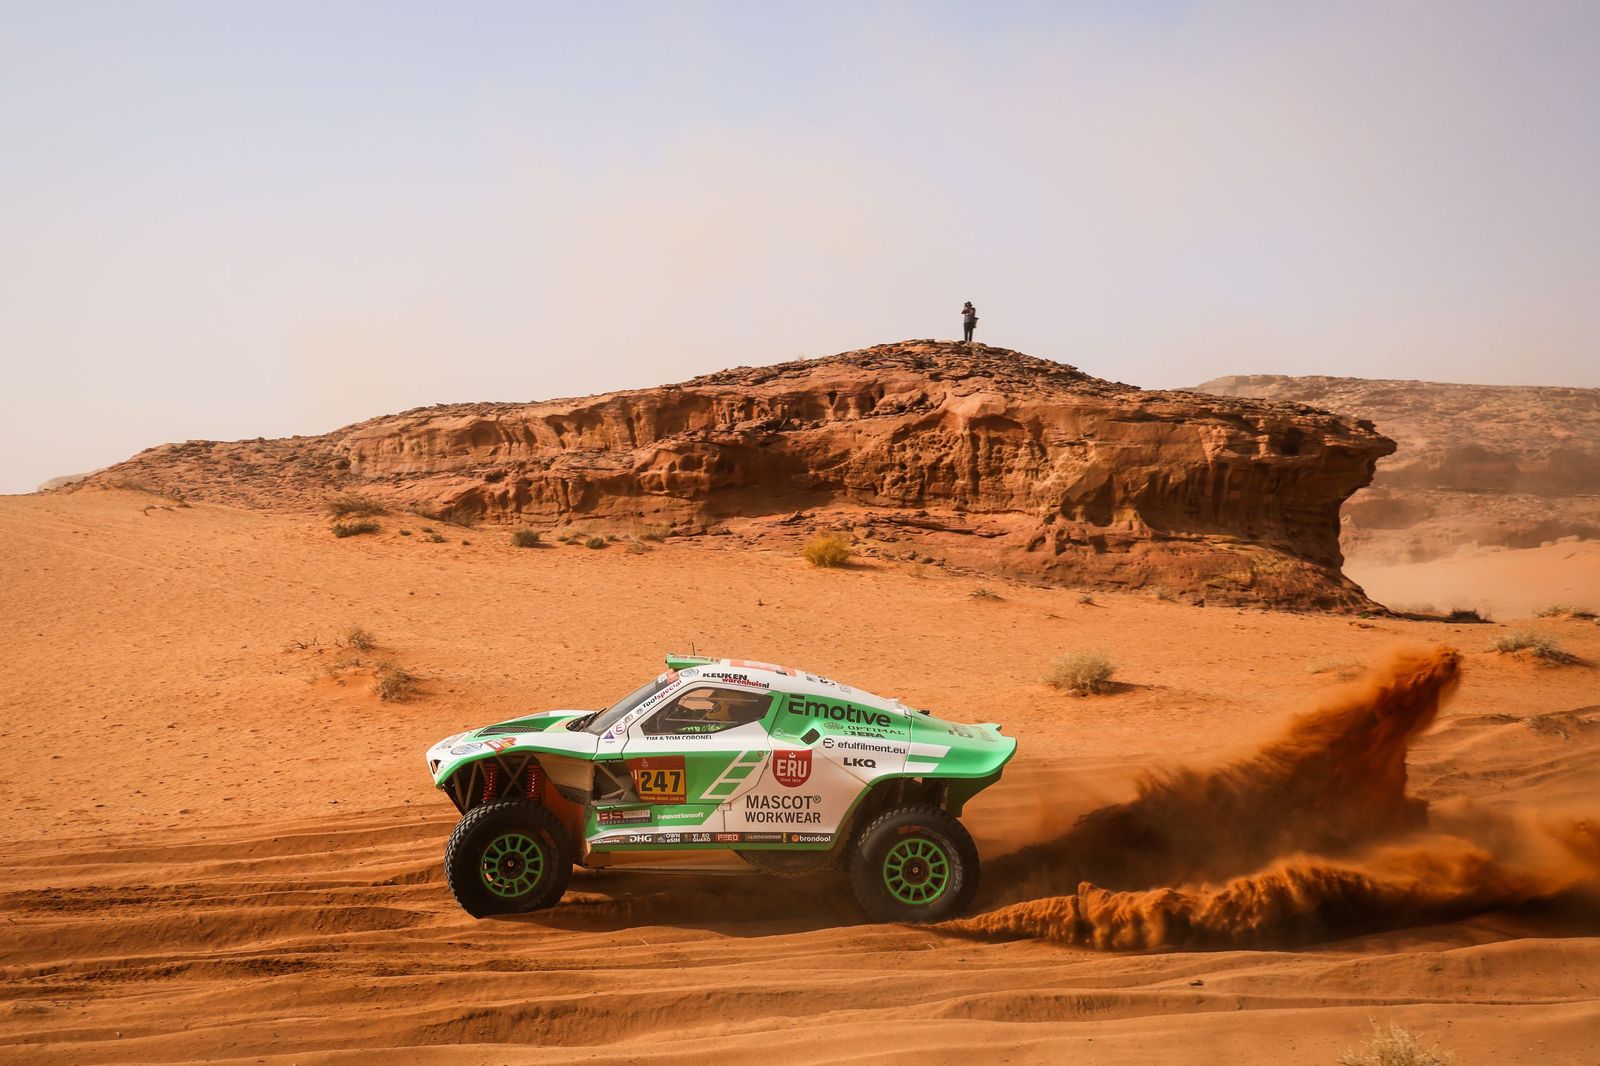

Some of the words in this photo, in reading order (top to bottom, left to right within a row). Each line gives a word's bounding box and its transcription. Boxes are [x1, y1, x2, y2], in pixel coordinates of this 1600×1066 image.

[702, 672, 747, 681] KEUKEN
[788, 694, 892, 728] Emotive
[837, 742, 906, 755] efulfilment.eu
[776, 759, 807, 778] ERU
[843, 757, 876, 768] LKQ
[640, 771, 681, 792] 247
[745, 812, 821, 823] WORKWEAR
[629, 835, 652, 843] DHG
